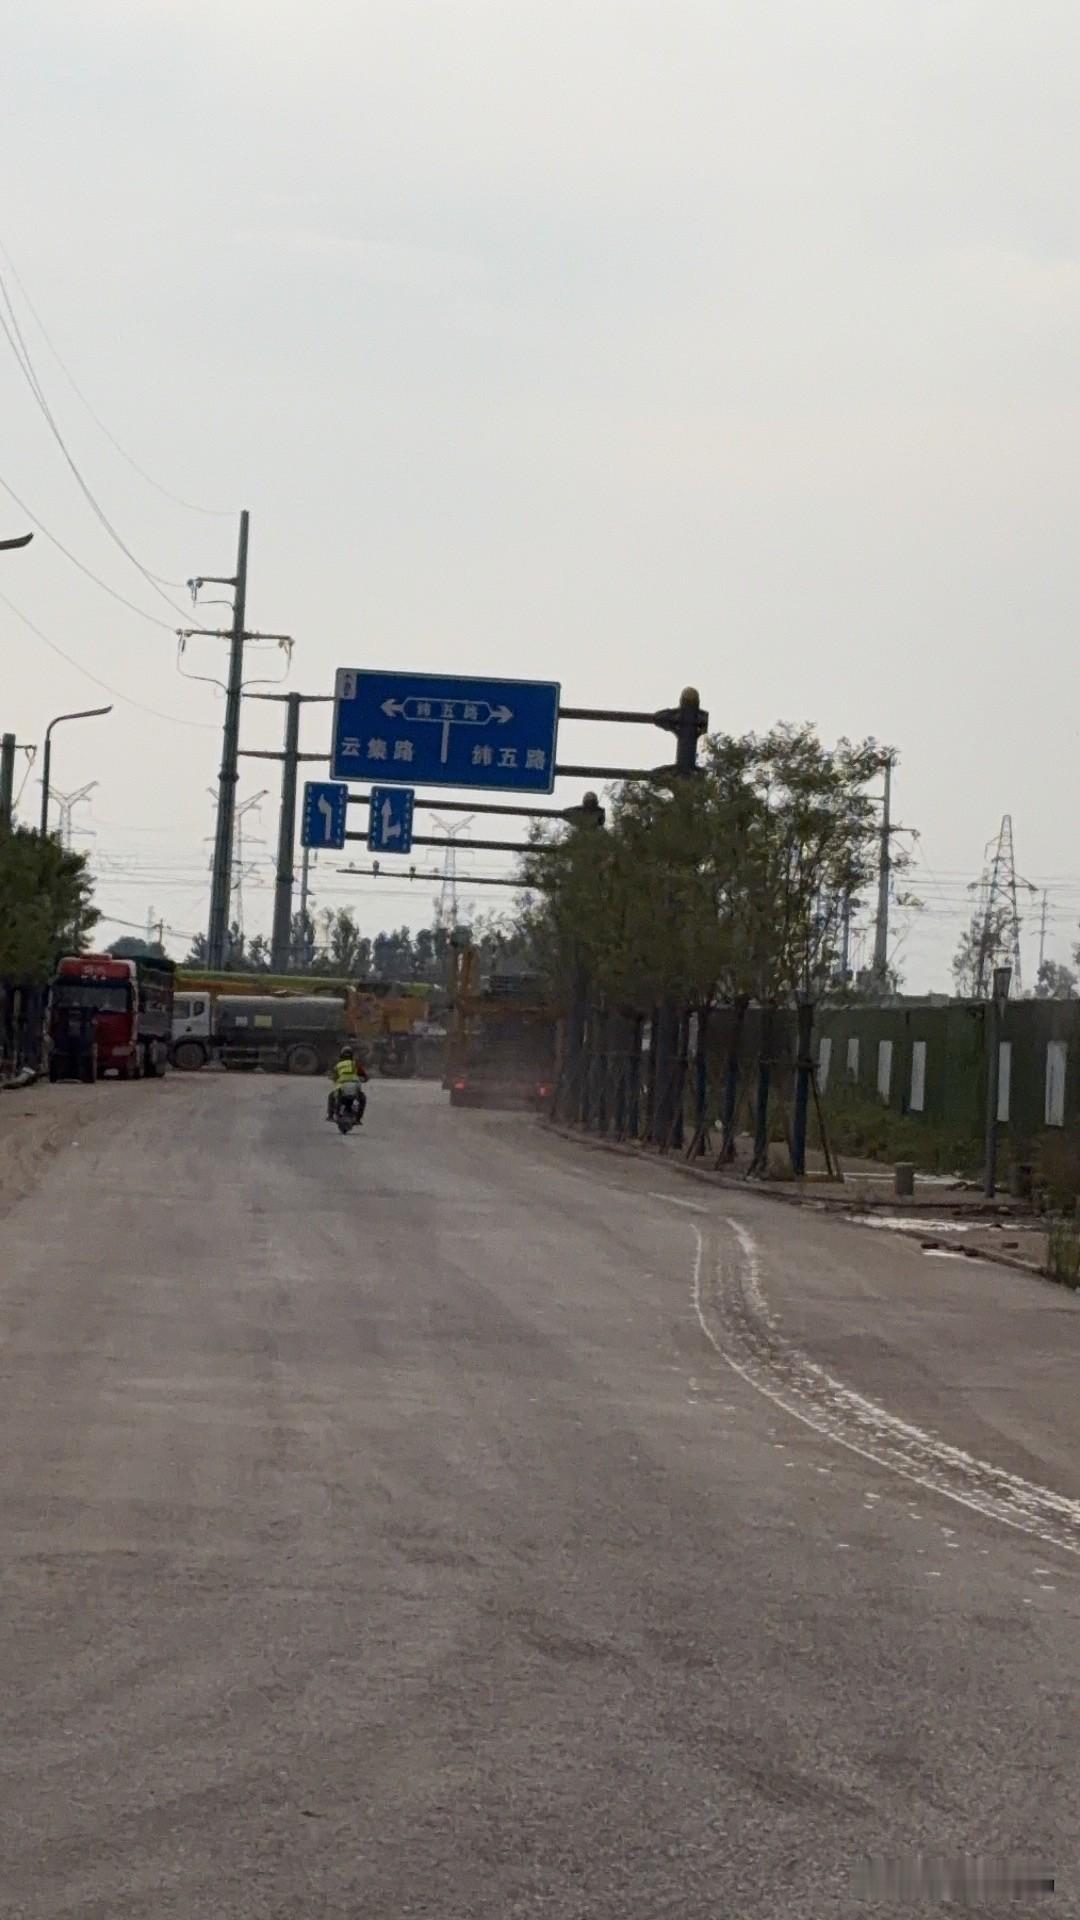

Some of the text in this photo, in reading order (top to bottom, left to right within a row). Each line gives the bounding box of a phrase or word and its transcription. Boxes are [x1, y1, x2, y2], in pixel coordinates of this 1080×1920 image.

[416, 701, 479, 720] 纬五路
[341, 736, 413, 762] 云集路
[471, 744, 545, 770] 纬五路
